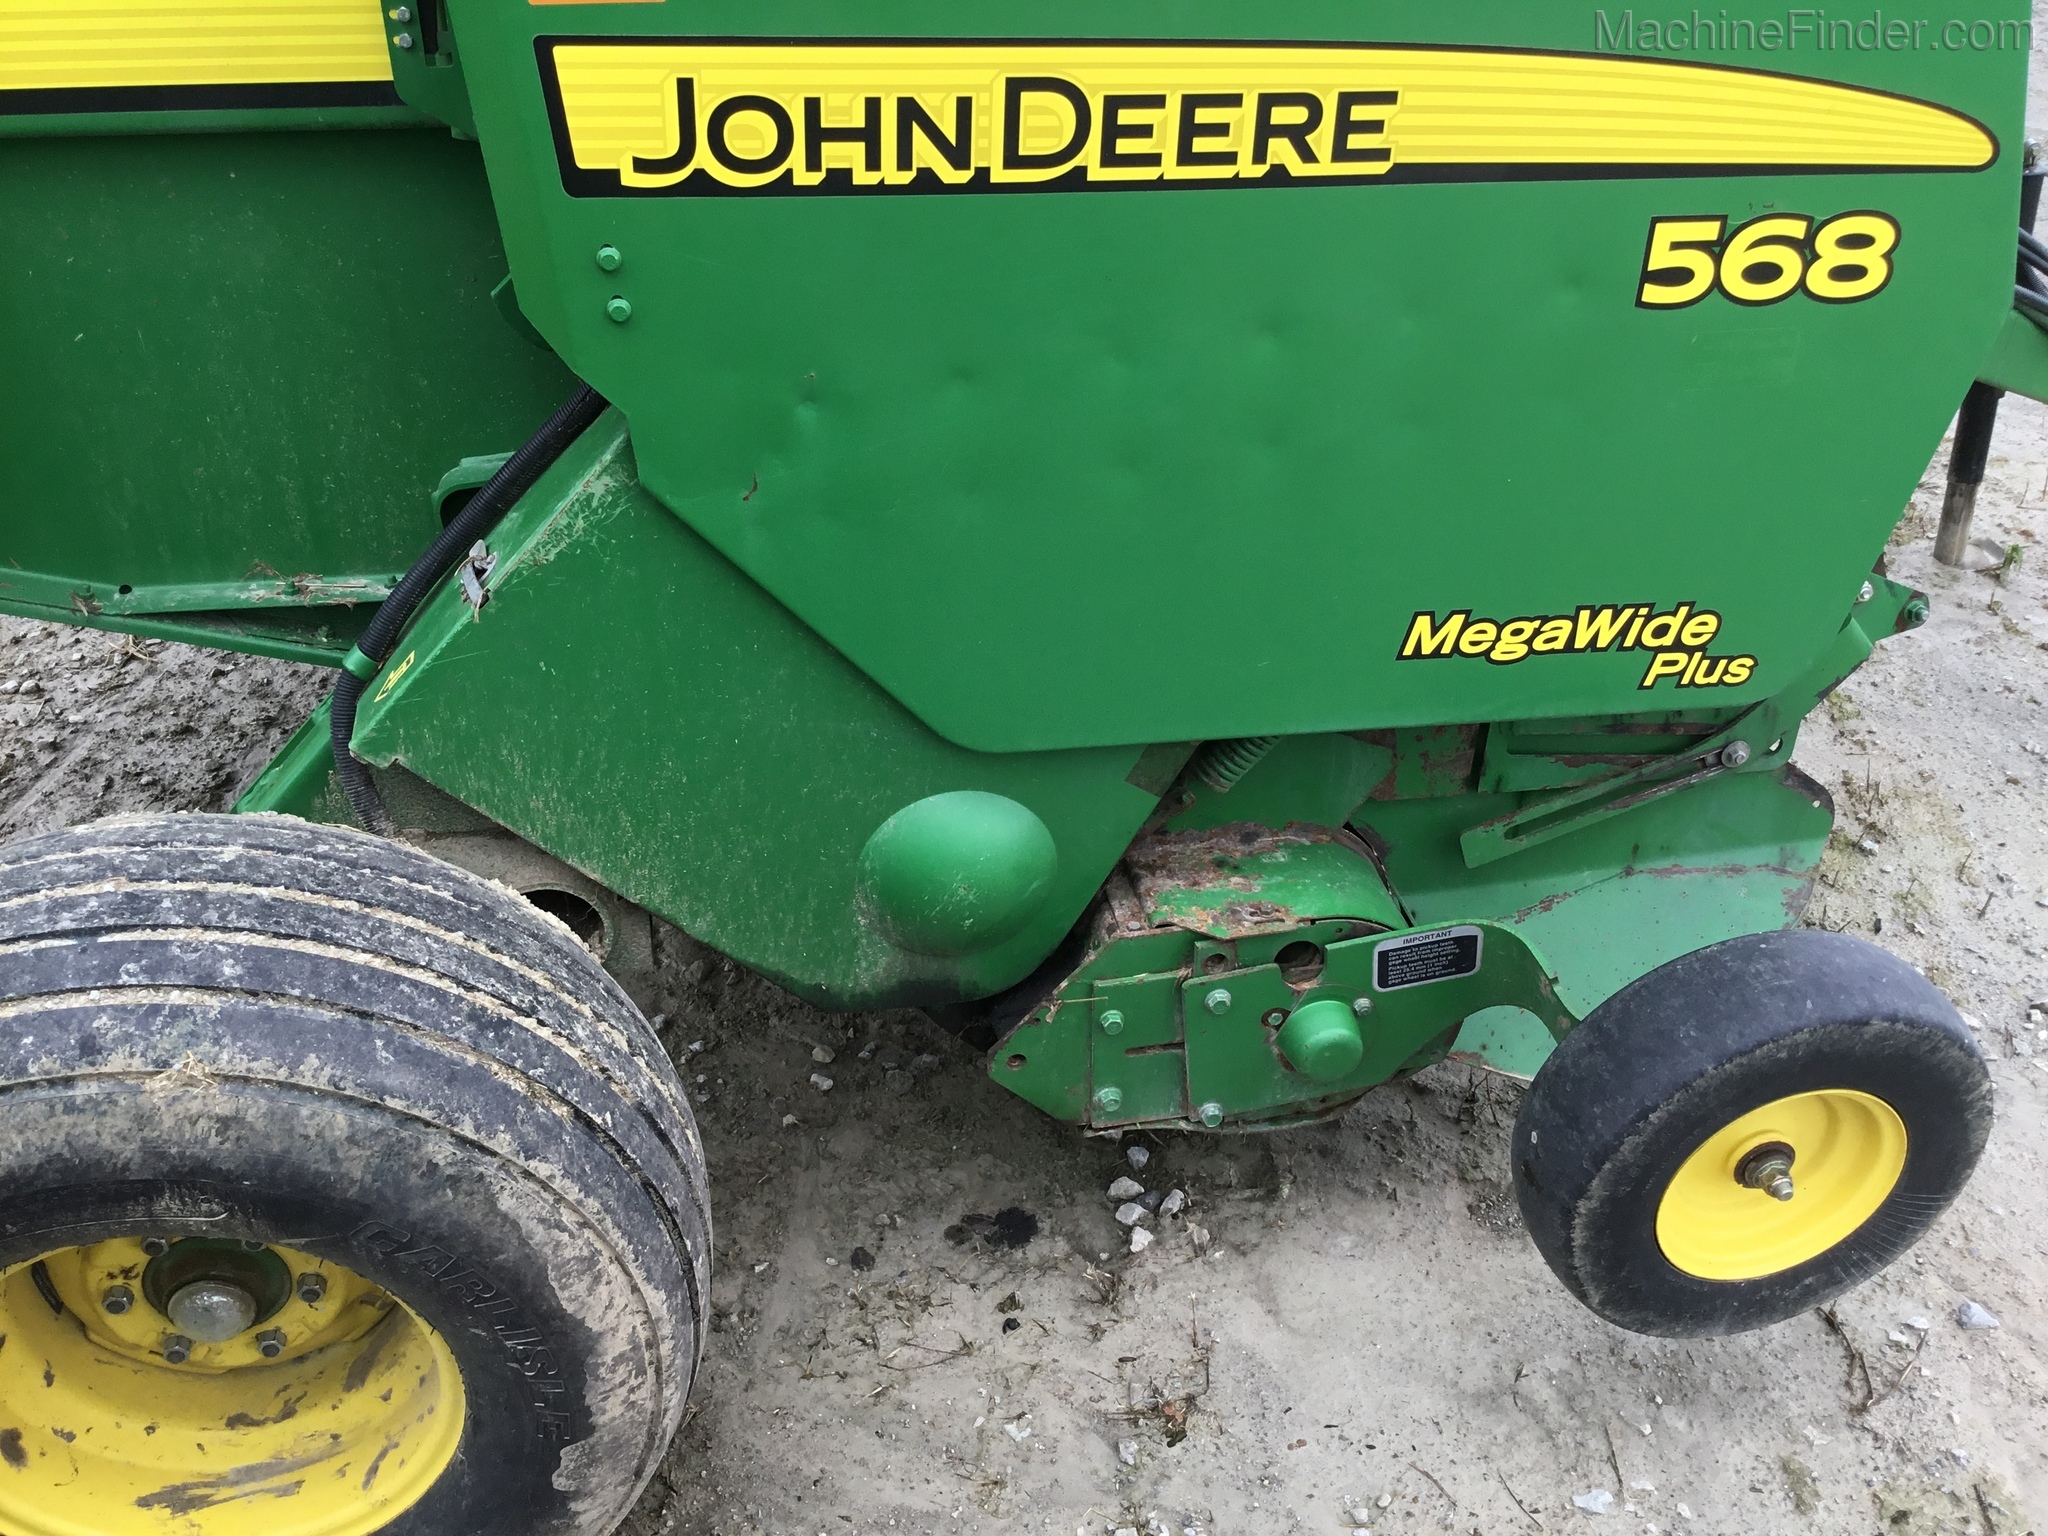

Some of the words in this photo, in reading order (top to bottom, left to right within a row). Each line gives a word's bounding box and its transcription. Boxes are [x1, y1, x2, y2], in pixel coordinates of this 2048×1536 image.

[628, 74, 976, 182] JOHN
[1002, 75, 1402, 175] DEERE
[1637, 211, 1899, 308] 568
[1399, 603, 1721, 663] MegaWide
[1640, 651, 1757, 689] Plus
[1388, 948, 1411, 957] Damage
[1419, 943, 1439, 951] pickup
[1402, 930, 1453, 945] IMPORTANT
[1400, 951, 1416, 959] result
[1431, 944, 1458, 954] improper
[1403, 954, 1420, 962] wheel
[1420, 951, 1439, 959] height
[1388, 963, 1408, 971] Pickup
[347, 1218, 575, 1442] CARLISLE
